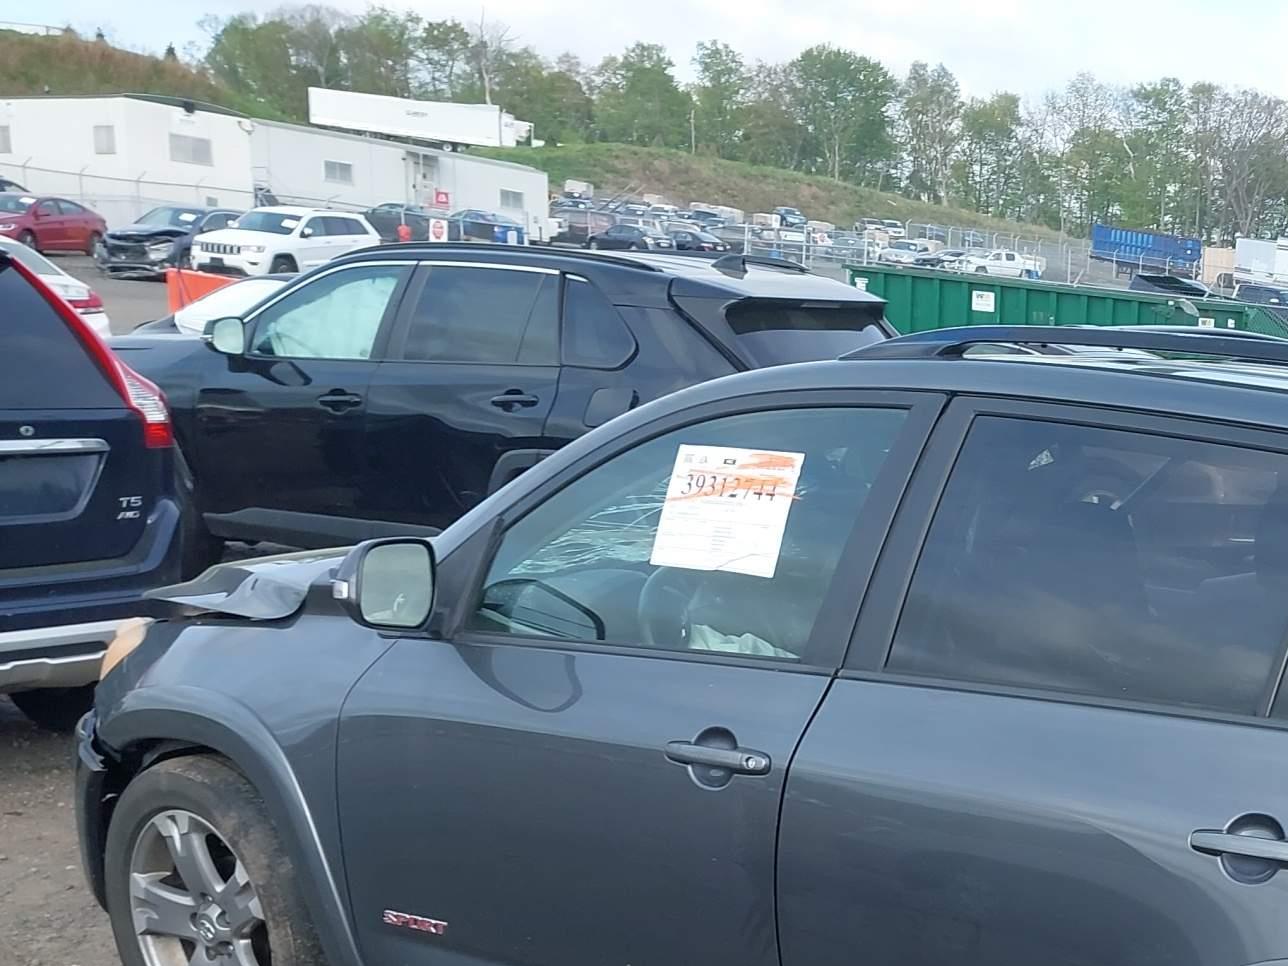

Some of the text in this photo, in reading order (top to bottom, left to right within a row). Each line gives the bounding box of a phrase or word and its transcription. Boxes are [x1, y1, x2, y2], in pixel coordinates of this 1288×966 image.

[680, 473, 777, 502] 39312744
[118, 495, 143, 508] T5
[382, 909, 448, 935] SPORT
